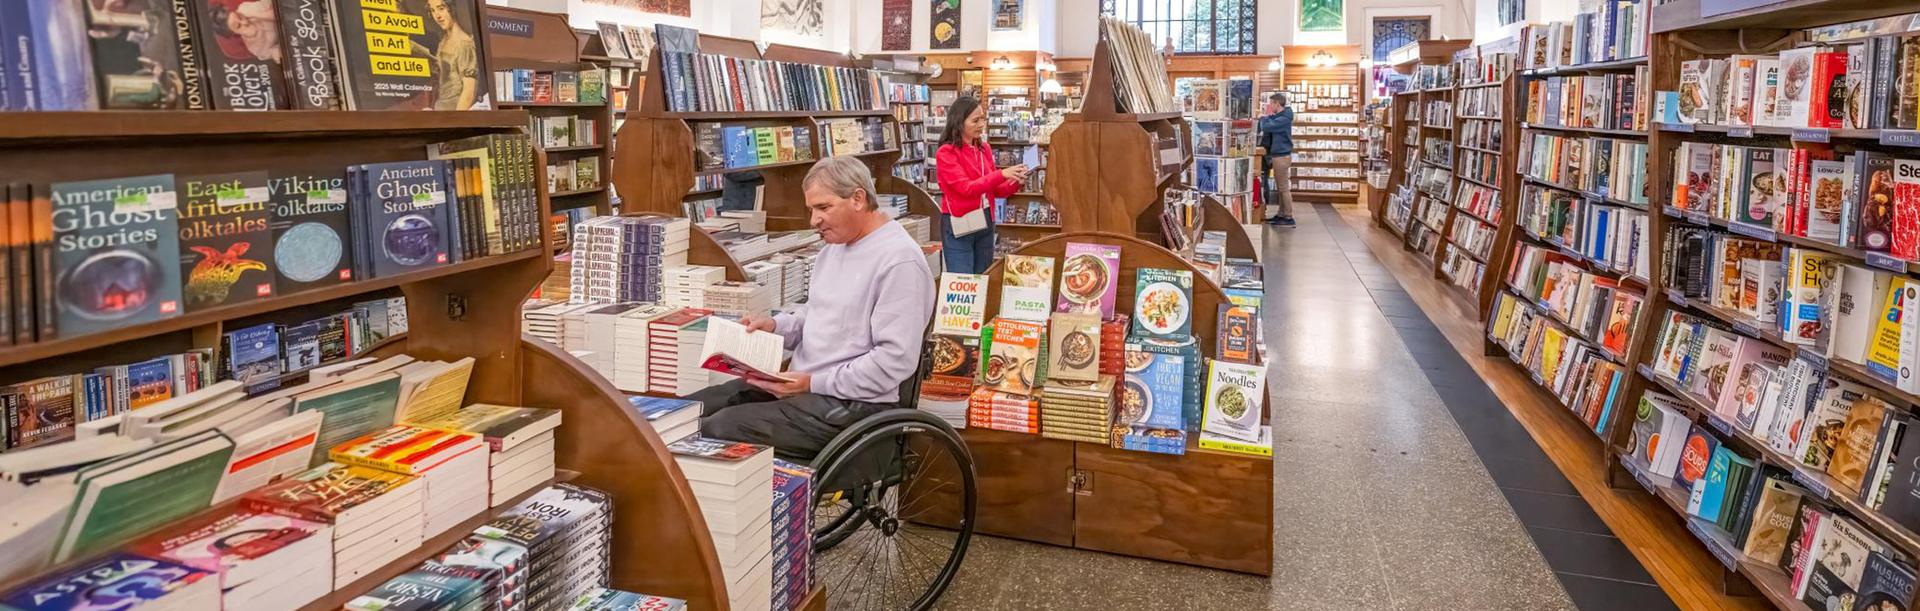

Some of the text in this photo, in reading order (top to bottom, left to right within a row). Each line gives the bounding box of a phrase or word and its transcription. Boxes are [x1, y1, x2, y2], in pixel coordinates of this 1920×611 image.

[368, 13, 419, 30] to Avoid
[371, 37, 406, 50] in Art
[376, 59, 424, 73] and Life
[182, 43, 202, 110] JONATHAN
[224, 64, 246, 106] BOOK
[302, 46, 329, 107] Book
[1753, 151, 1771, 161] EAT
[379, 166, 434, 181] Ancient
[52, 183, 164, 207] American
[187, 179, 242, 198] East
[268, 175, 343, 196] Viking
[377, 179, 439, 200] Ghost
[51, 205, 168, 234] Ghost
[180, 216, 268, 241] olktales
[59, 228, 158, 252] Stories
[949, 281, 978, 293] COOK
[946, 292, 977, 305] WHAT
[1015, 300, 1046, 309] PASTA
[949, 304, 971, 316] YOU
[941, 316, 972, 329] HAVE
[997, 328, 1014, 336] TEST
[995, 335, 1025, 343] KITCHEN
[1150, 346, 1180, 354] KITCHEN
[36, 381, 60, 392] WALK
[1217, 371, 1257, 389] Noodles
[49, 386, 72, 398] PARK
[371, 428, 424, 450] BURNING
[1683, 444, 1708, 473] SOUPS
[281, 468, 349, 500] FIND
[314, 475, 357, 500] ME
[522, 511, 553, 522] CAST
[525, 501, 572, 519] IRON
[489, 520, 541, 540] PETER
[567, 511, 597, 533] CAST IRON
[568, 525, 598, 548] CAST IRON
[1832, 519, 1872, 551] Six Seasons
[566, 541, 596, 564] CAST IRON
[565, 557, 595, 580] CAST IRON
[33, 559, 160, 606] ASTRA
[565, 570, 595, 595] CAST IRON
